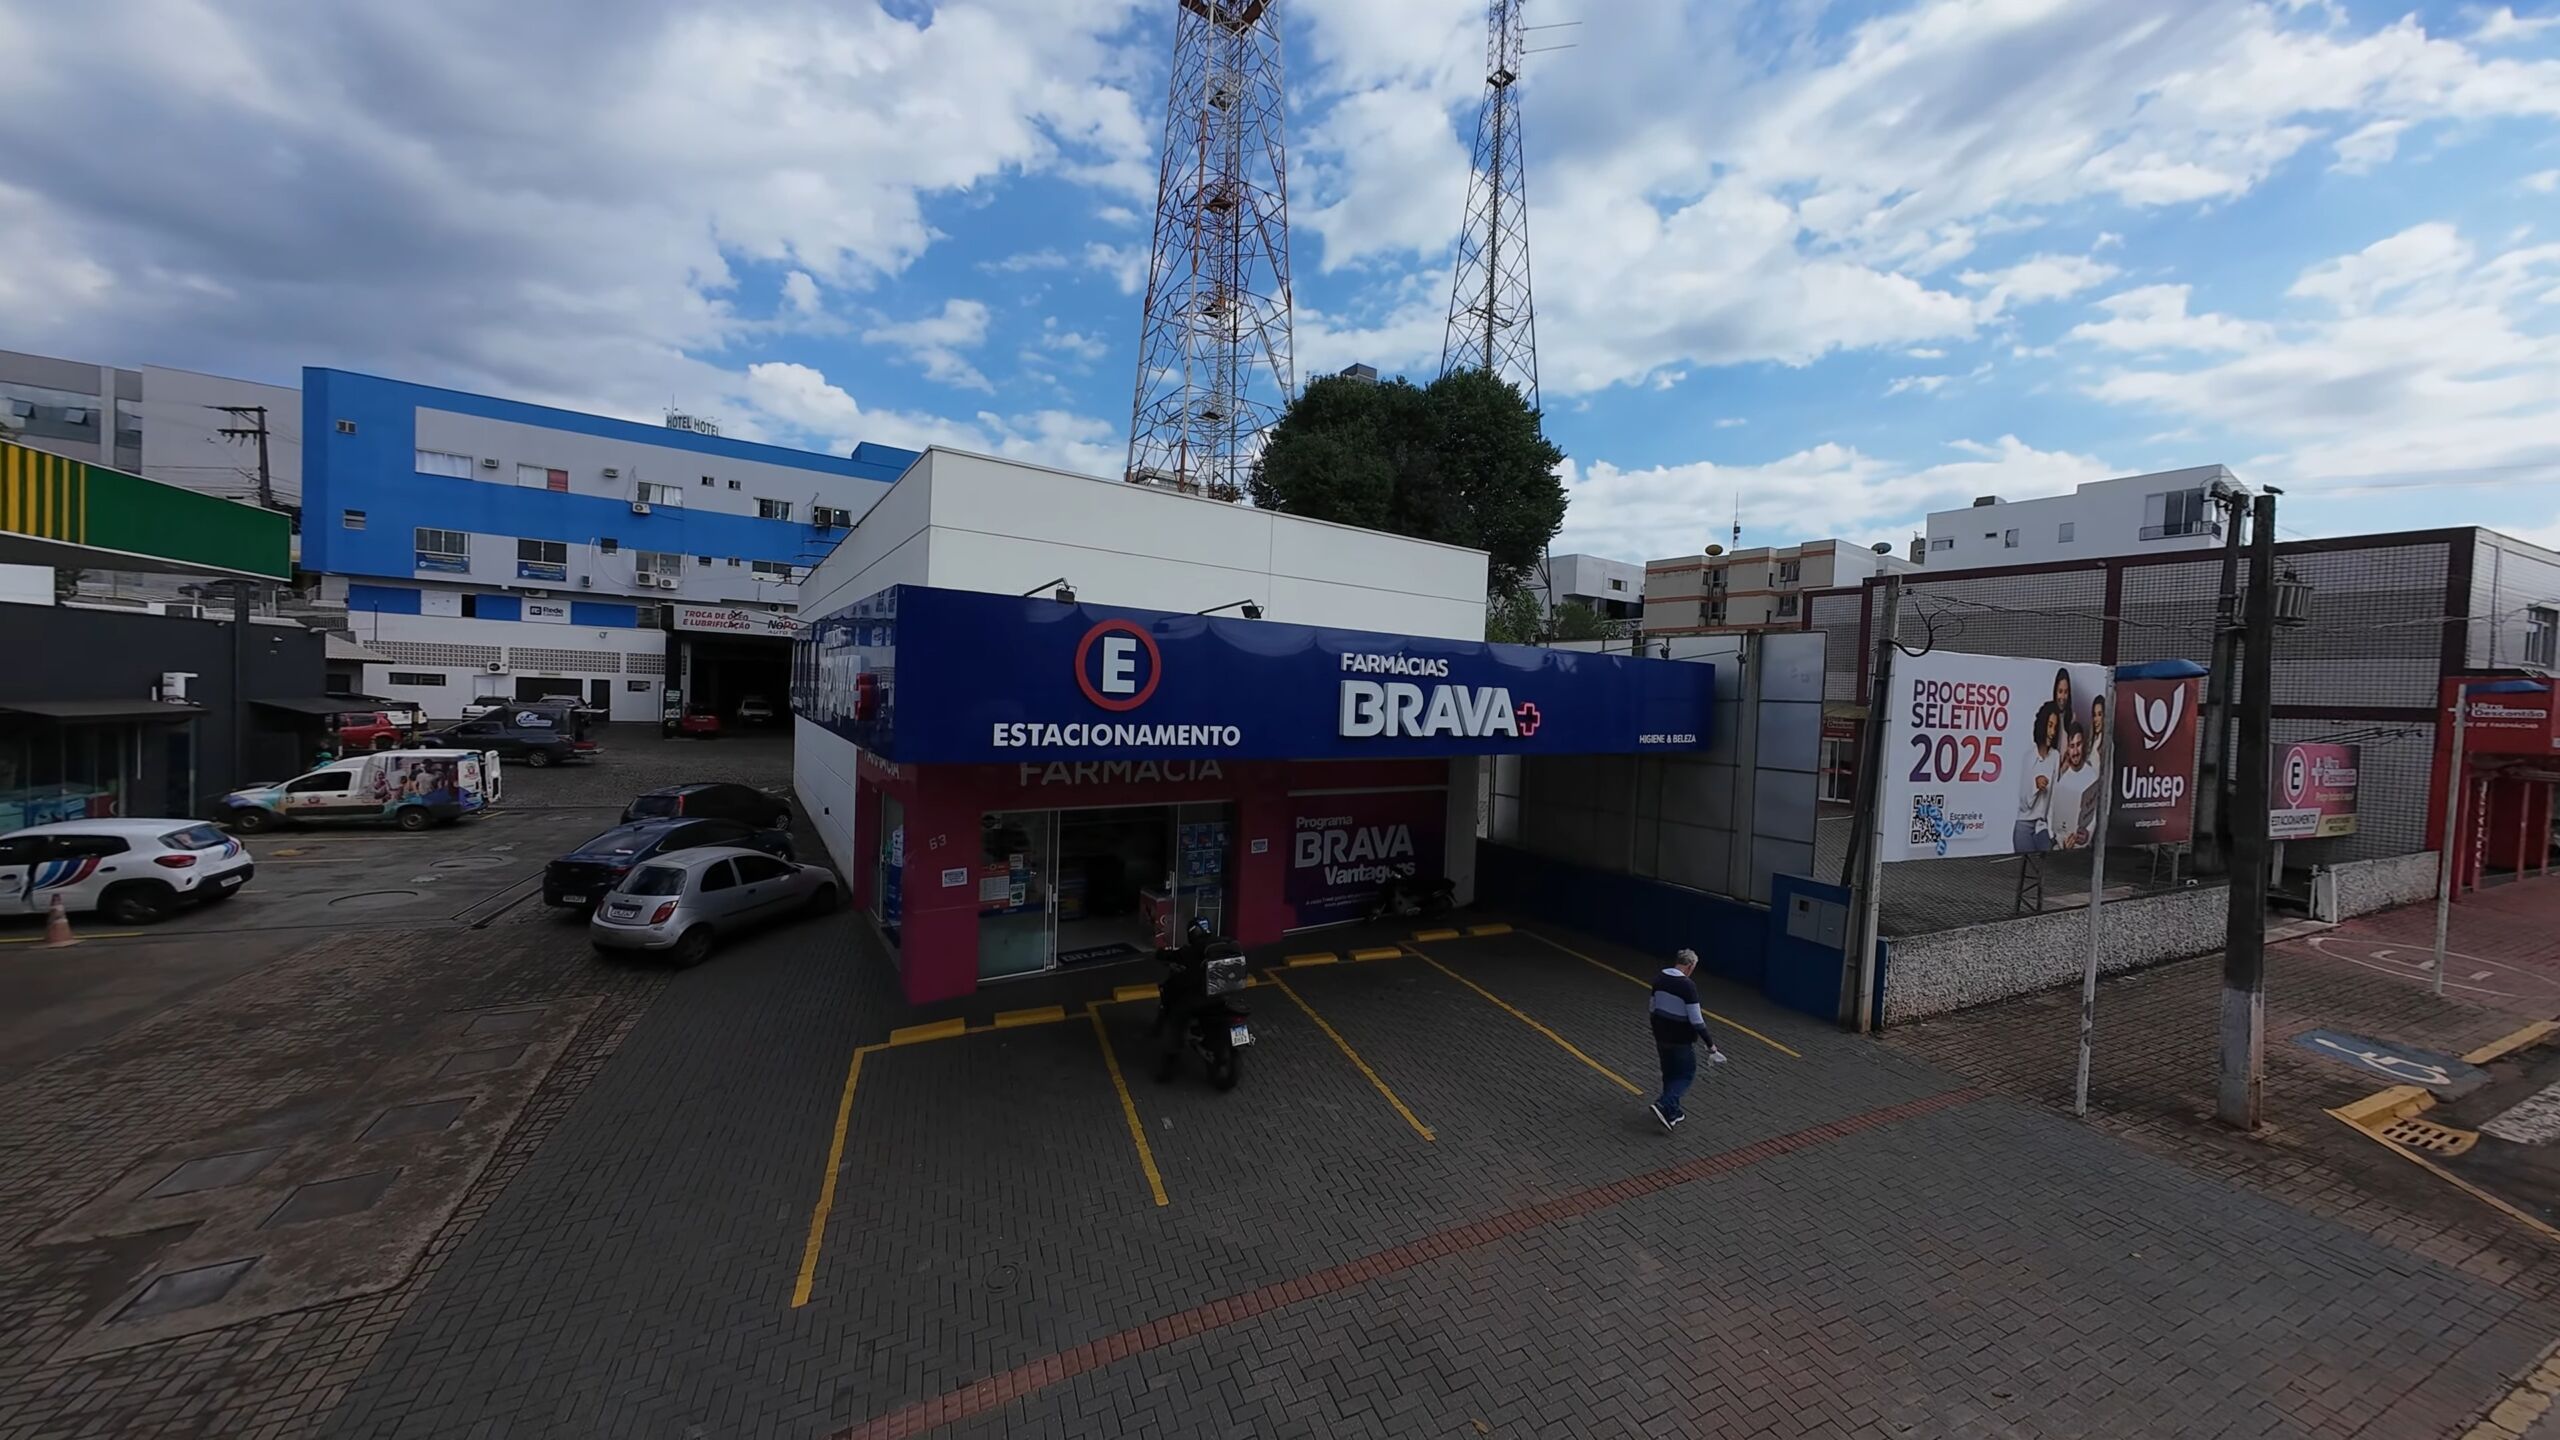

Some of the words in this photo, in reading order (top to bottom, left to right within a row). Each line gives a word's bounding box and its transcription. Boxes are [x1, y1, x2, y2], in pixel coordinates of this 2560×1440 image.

[666, 416, 691, 429] HOTEL
[685, 610, 712, 619] TROCA
[715, 611, 726, 620] DE
[1102, 636, 1136, 693] E
[1340, 652, 1449, 677] FARMÁCIAS
[1914, 679, 2010, 707] PROCESSO
[1339, 680, 1518, 737] BRAVA
[1911, 702, 2008, 731] SELETIVO
[993, 723, 1241, 746] ESTACIONAMENTO
[1639, 734, 1666, 744] HIGIENE
[1666, 734, 1672, 743] &
[1672, 734, 1696, 743] BELEZA
[1909, 733, 2003, 783] 2025
[2121, 766, 2184, 807] Unisep
[2291, 762, 2301, 790] E
[1296, 816, 1353, 830] Programa
[929, 834, 947, 850] 63
[1295, 824, 1414, 869] BRAVA
